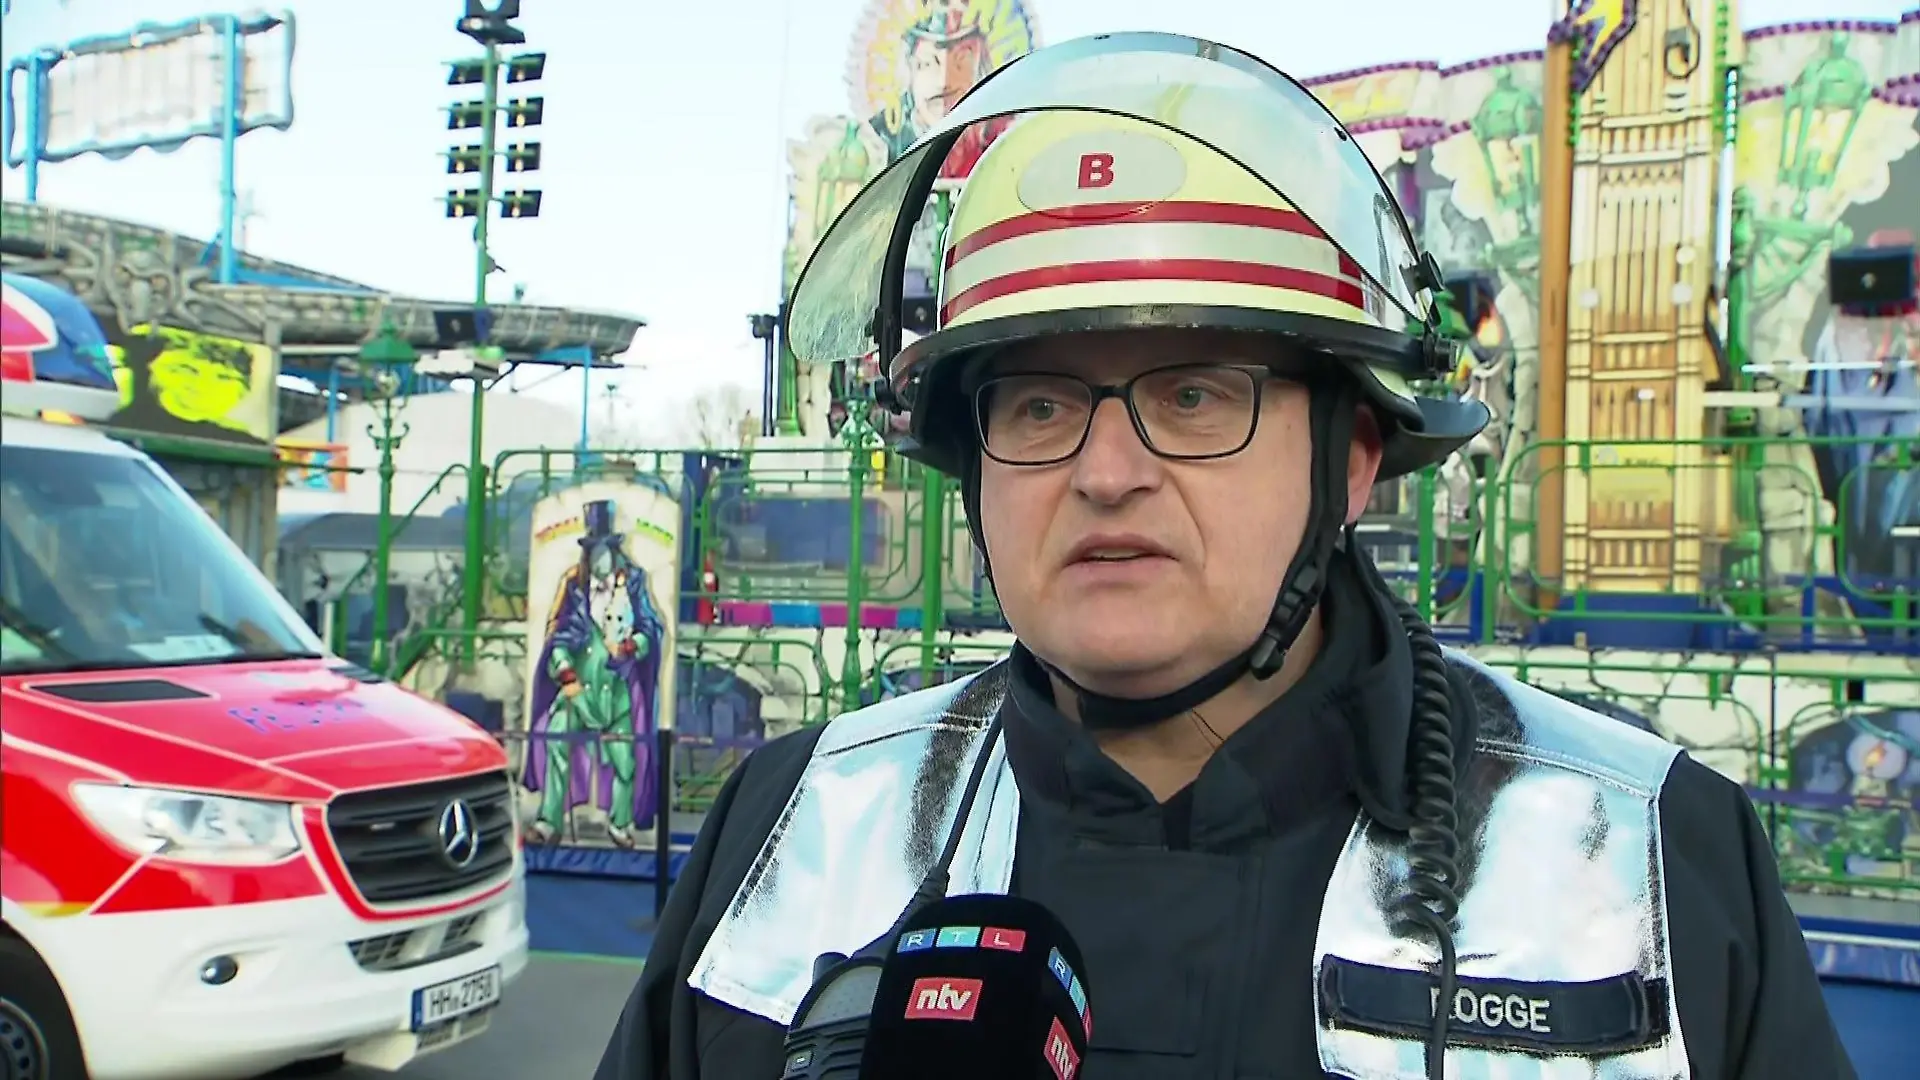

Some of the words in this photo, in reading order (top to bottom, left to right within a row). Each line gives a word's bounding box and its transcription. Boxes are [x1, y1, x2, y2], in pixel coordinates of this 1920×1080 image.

[1078, 153, 1114, 188] B
[905, 930, 1011, 948] RTL
[916, 983, 971, 1010] ntv
